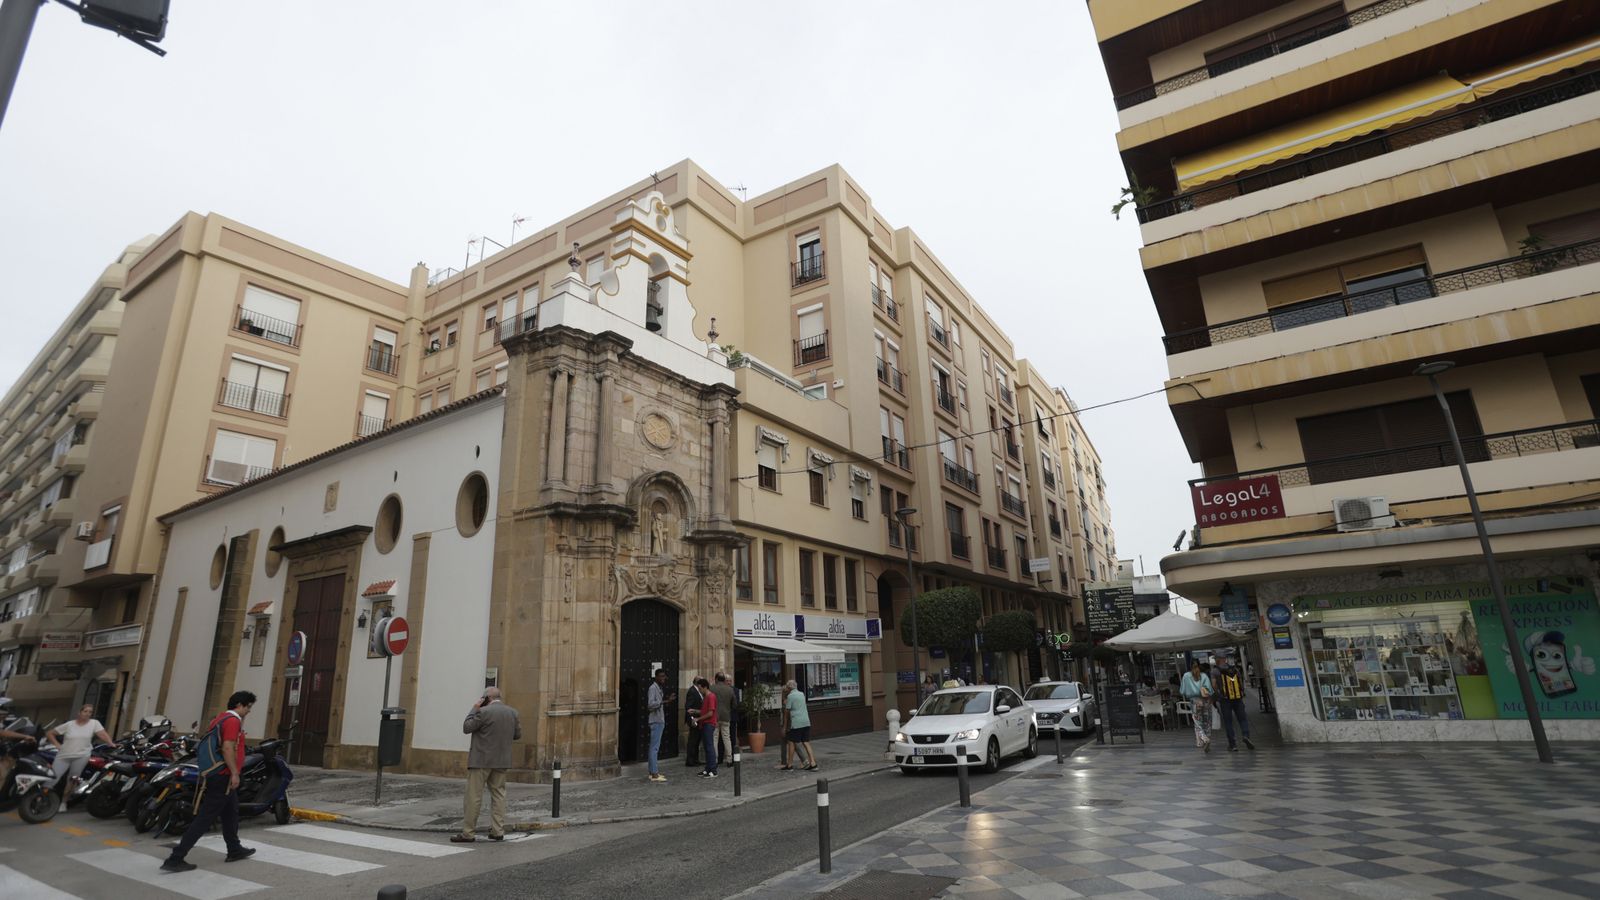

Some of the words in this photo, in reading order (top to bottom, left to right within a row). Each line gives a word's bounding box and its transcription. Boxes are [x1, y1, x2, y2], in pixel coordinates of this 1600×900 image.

[1201, 505, 1278, 523] ABOGADOS
[1334, 591, 1417, 608] ACCESORIOS
[1424, 587, 1463, 601] PARA
[1468, 583, 1535, 598] MOILES
[1479, 599, 1589, 616] REARACION
[753, 612, 776, 631] aldía
[828, 618, 845, 634] aldía
[1503, 701, 1554, 713] MOIL
